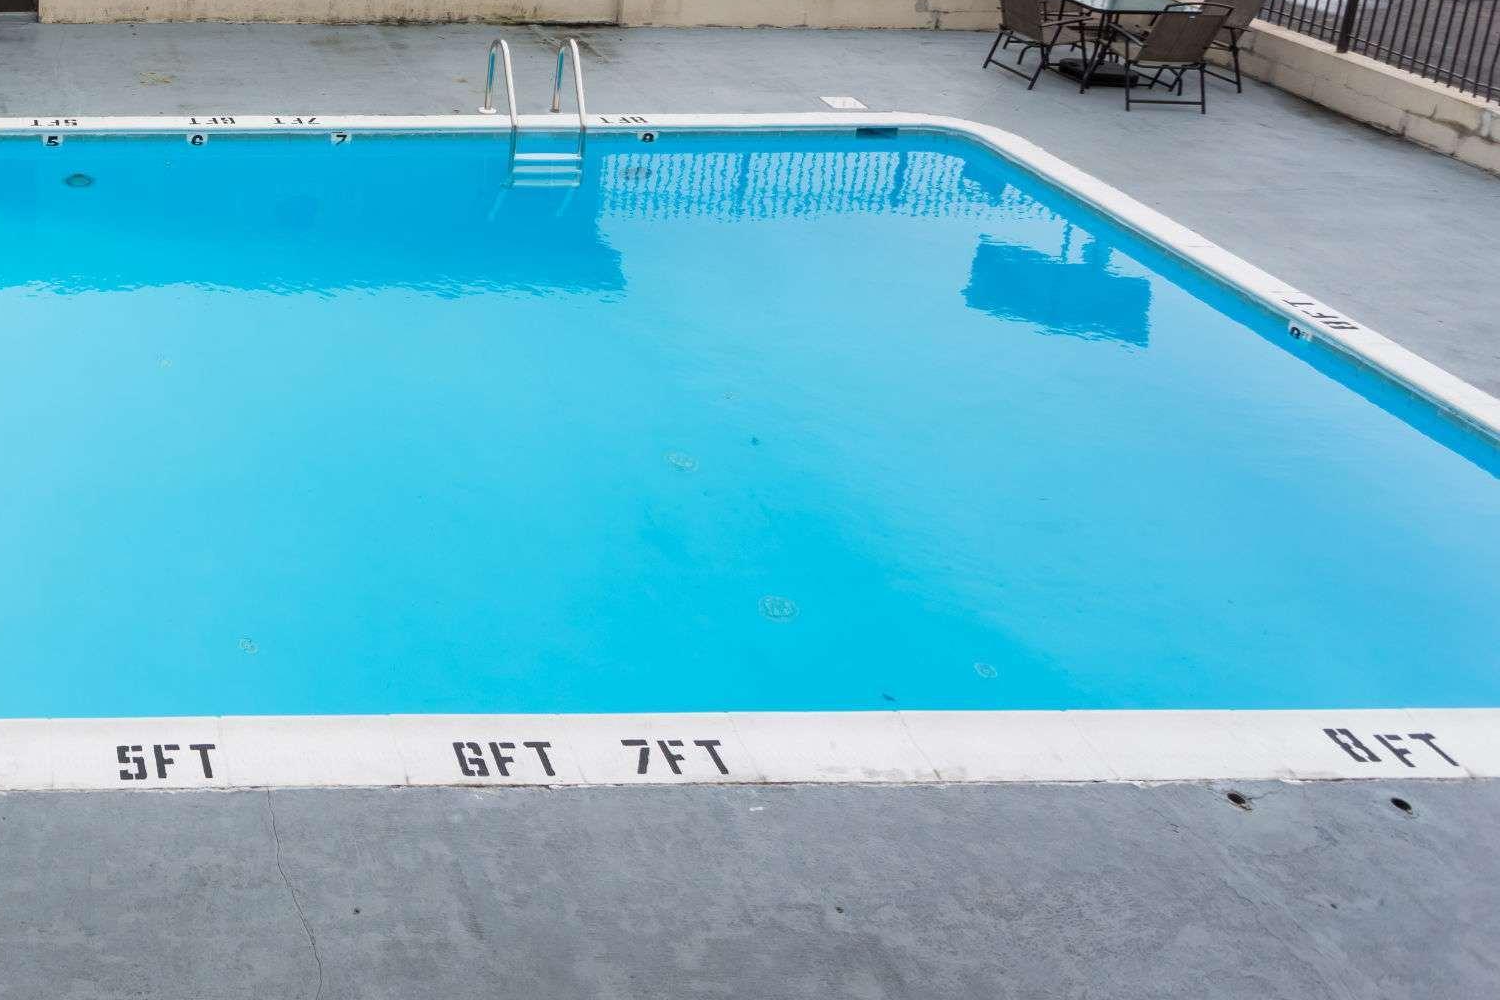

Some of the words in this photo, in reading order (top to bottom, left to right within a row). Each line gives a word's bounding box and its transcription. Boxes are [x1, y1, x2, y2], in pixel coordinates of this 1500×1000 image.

[46, 135, 60, 146] 5
[336, 134, 348, 146] 7
[1281, 299, 1359, 330] 8FT
[116, 744, 216, 780] 5FT
[452, 741, 556, 777] 6FT
[620, 739, 730, 775] 7FT
[1322, 728, 1460, 768] 8FT
